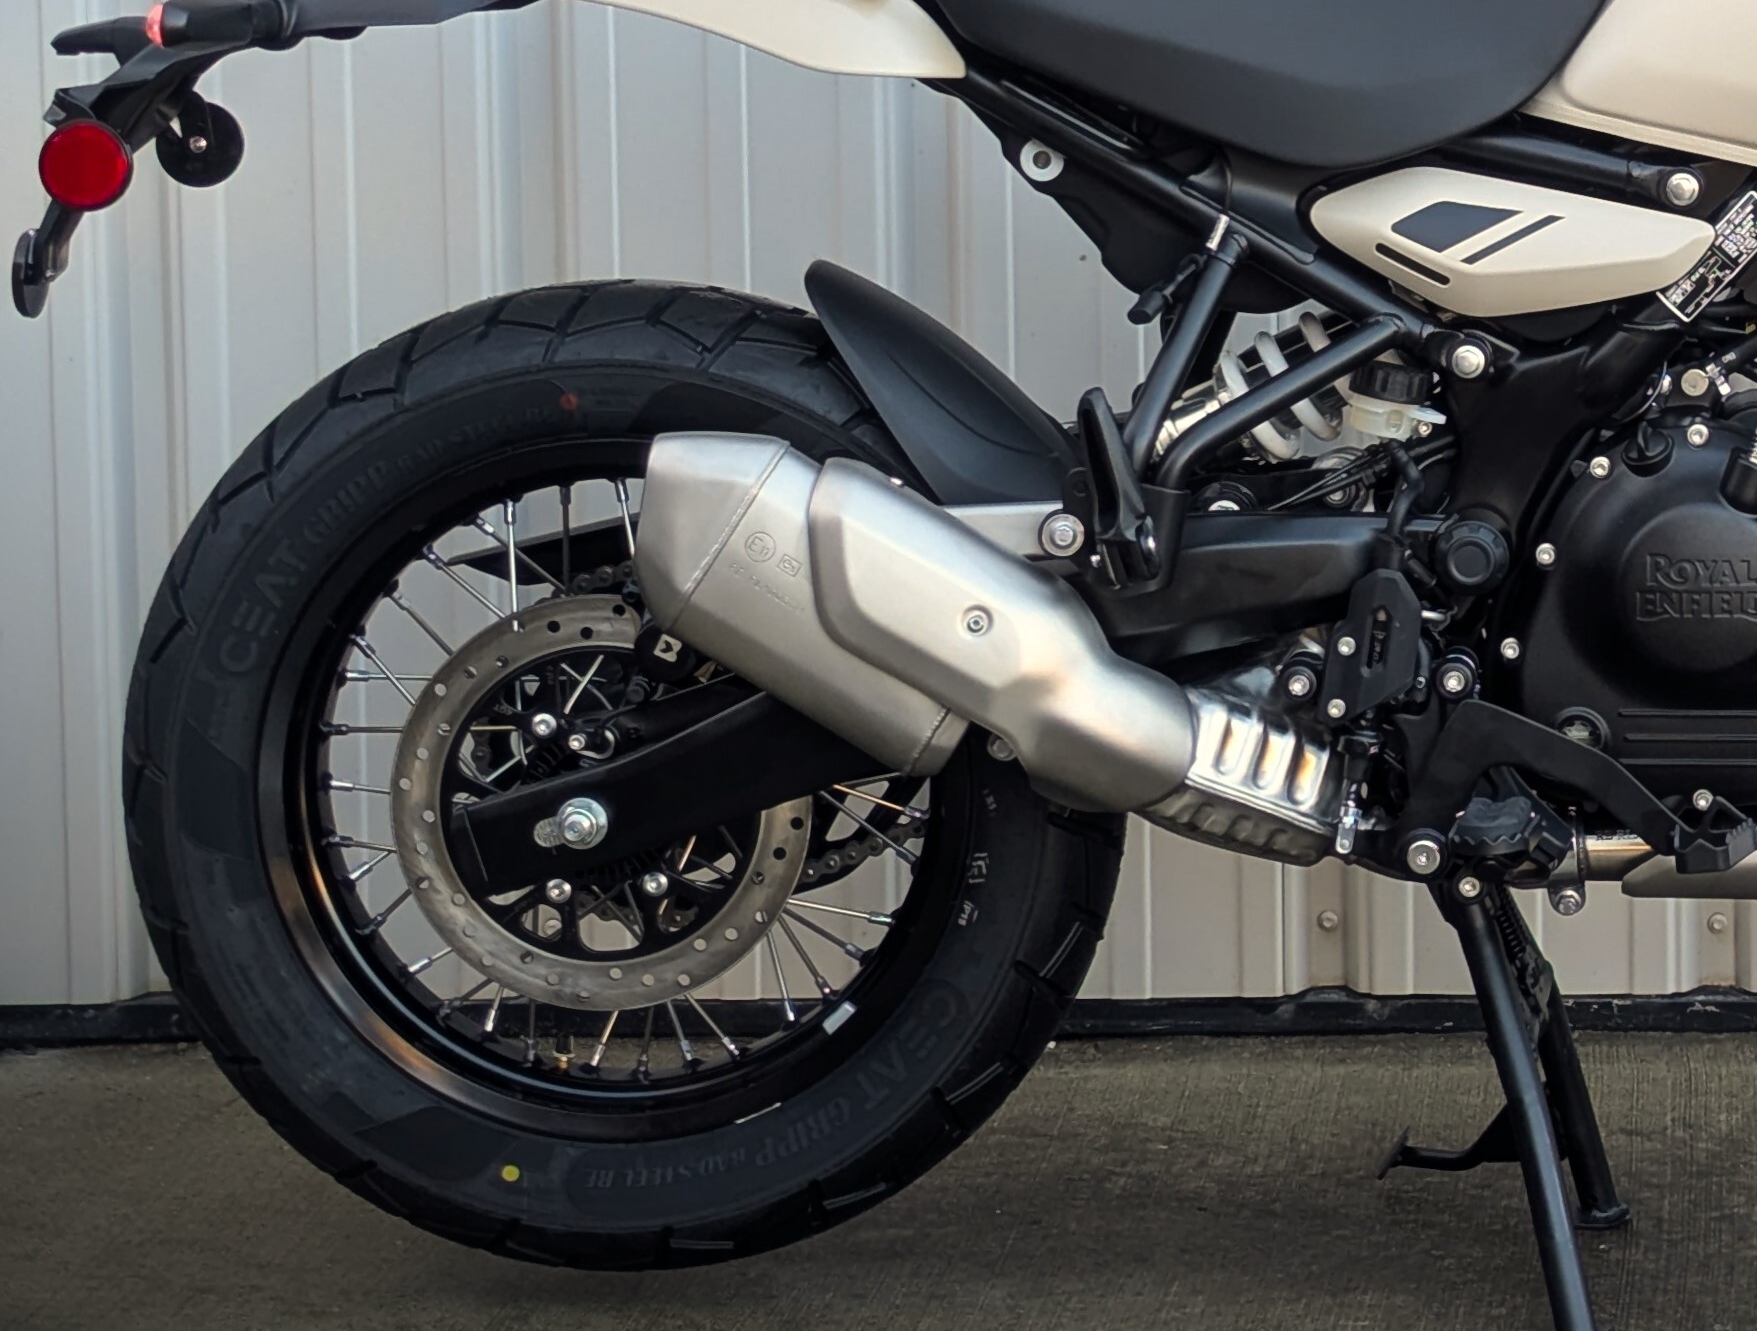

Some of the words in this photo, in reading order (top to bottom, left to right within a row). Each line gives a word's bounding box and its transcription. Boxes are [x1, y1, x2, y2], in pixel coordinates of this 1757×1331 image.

[217, 536, 315, 672] CEAT
[299, 456, 397, 547] GRIPP
[846, 983, 964, 1110] CEAT
[750, 1093, 857, 1167] GRIPP
